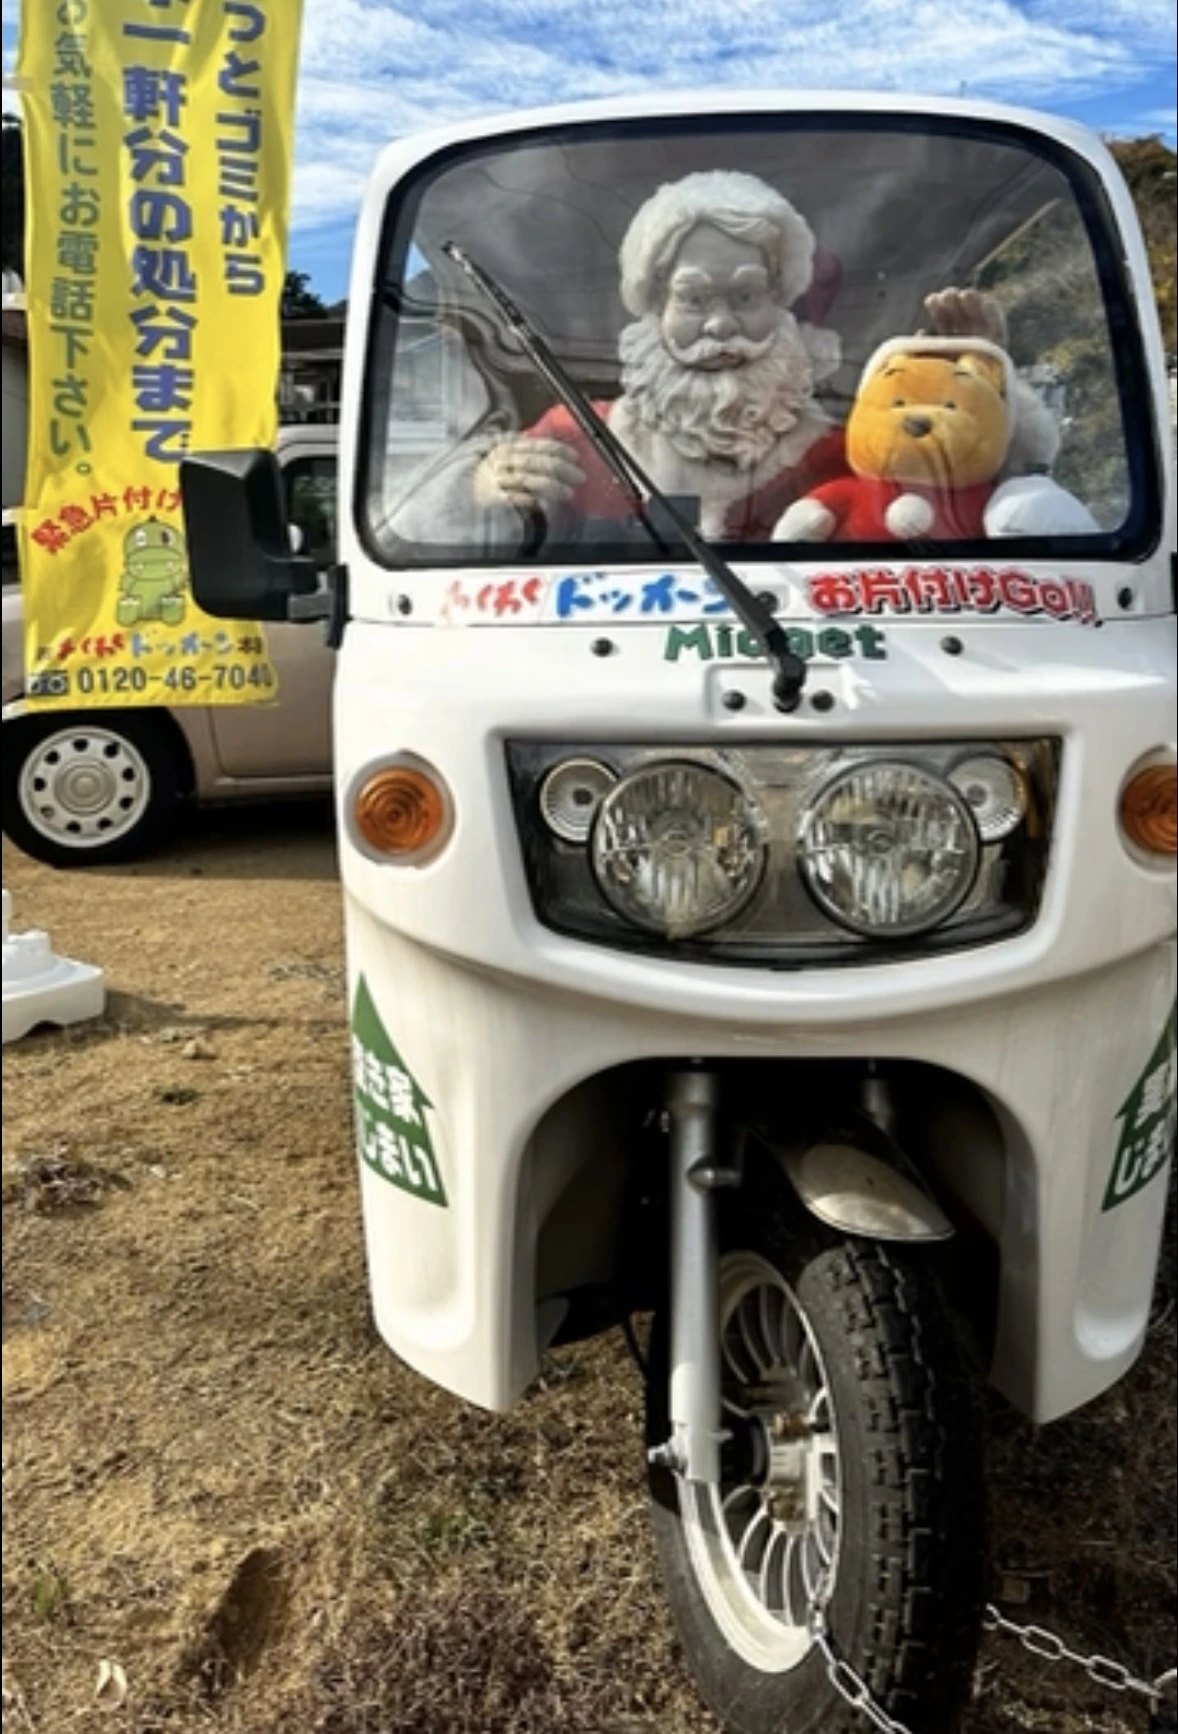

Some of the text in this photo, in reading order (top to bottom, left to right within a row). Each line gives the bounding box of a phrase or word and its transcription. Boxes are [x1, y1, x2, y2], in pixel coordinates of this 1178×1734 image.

[122, 0, 197, 463] 一軒分の処分まで
